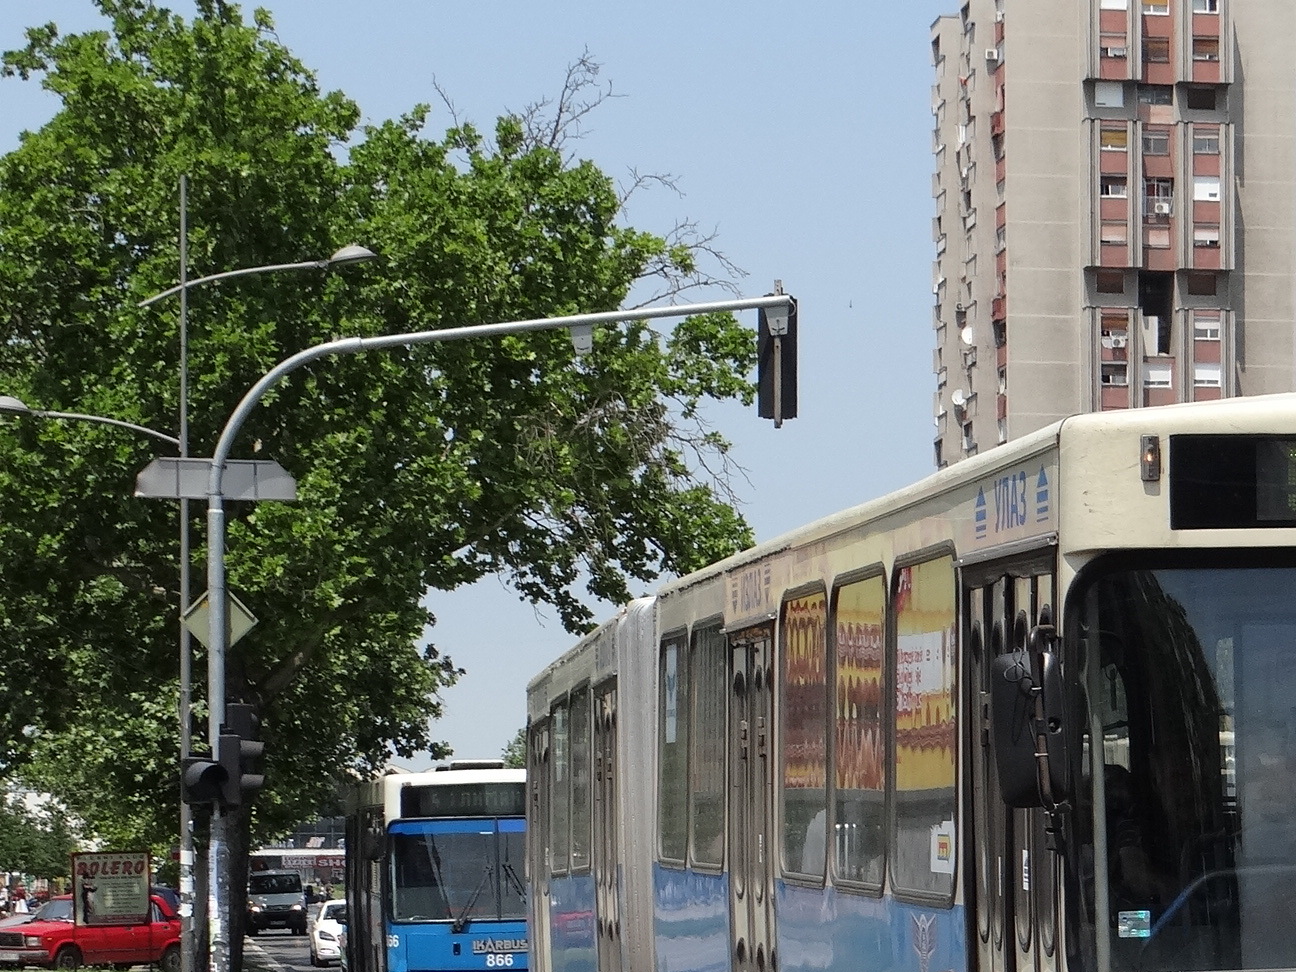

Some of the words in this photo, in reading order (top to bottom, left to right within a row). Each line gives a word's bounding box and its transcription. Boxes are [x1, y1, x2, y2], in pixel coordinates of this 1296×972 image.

[994, 470, 1028, 533] УЛАЗ
[77, 861, 145, 876] BOLERO
[472, 936, 528, 953] IKARBUS
[486, 954, 514, 968] 866
